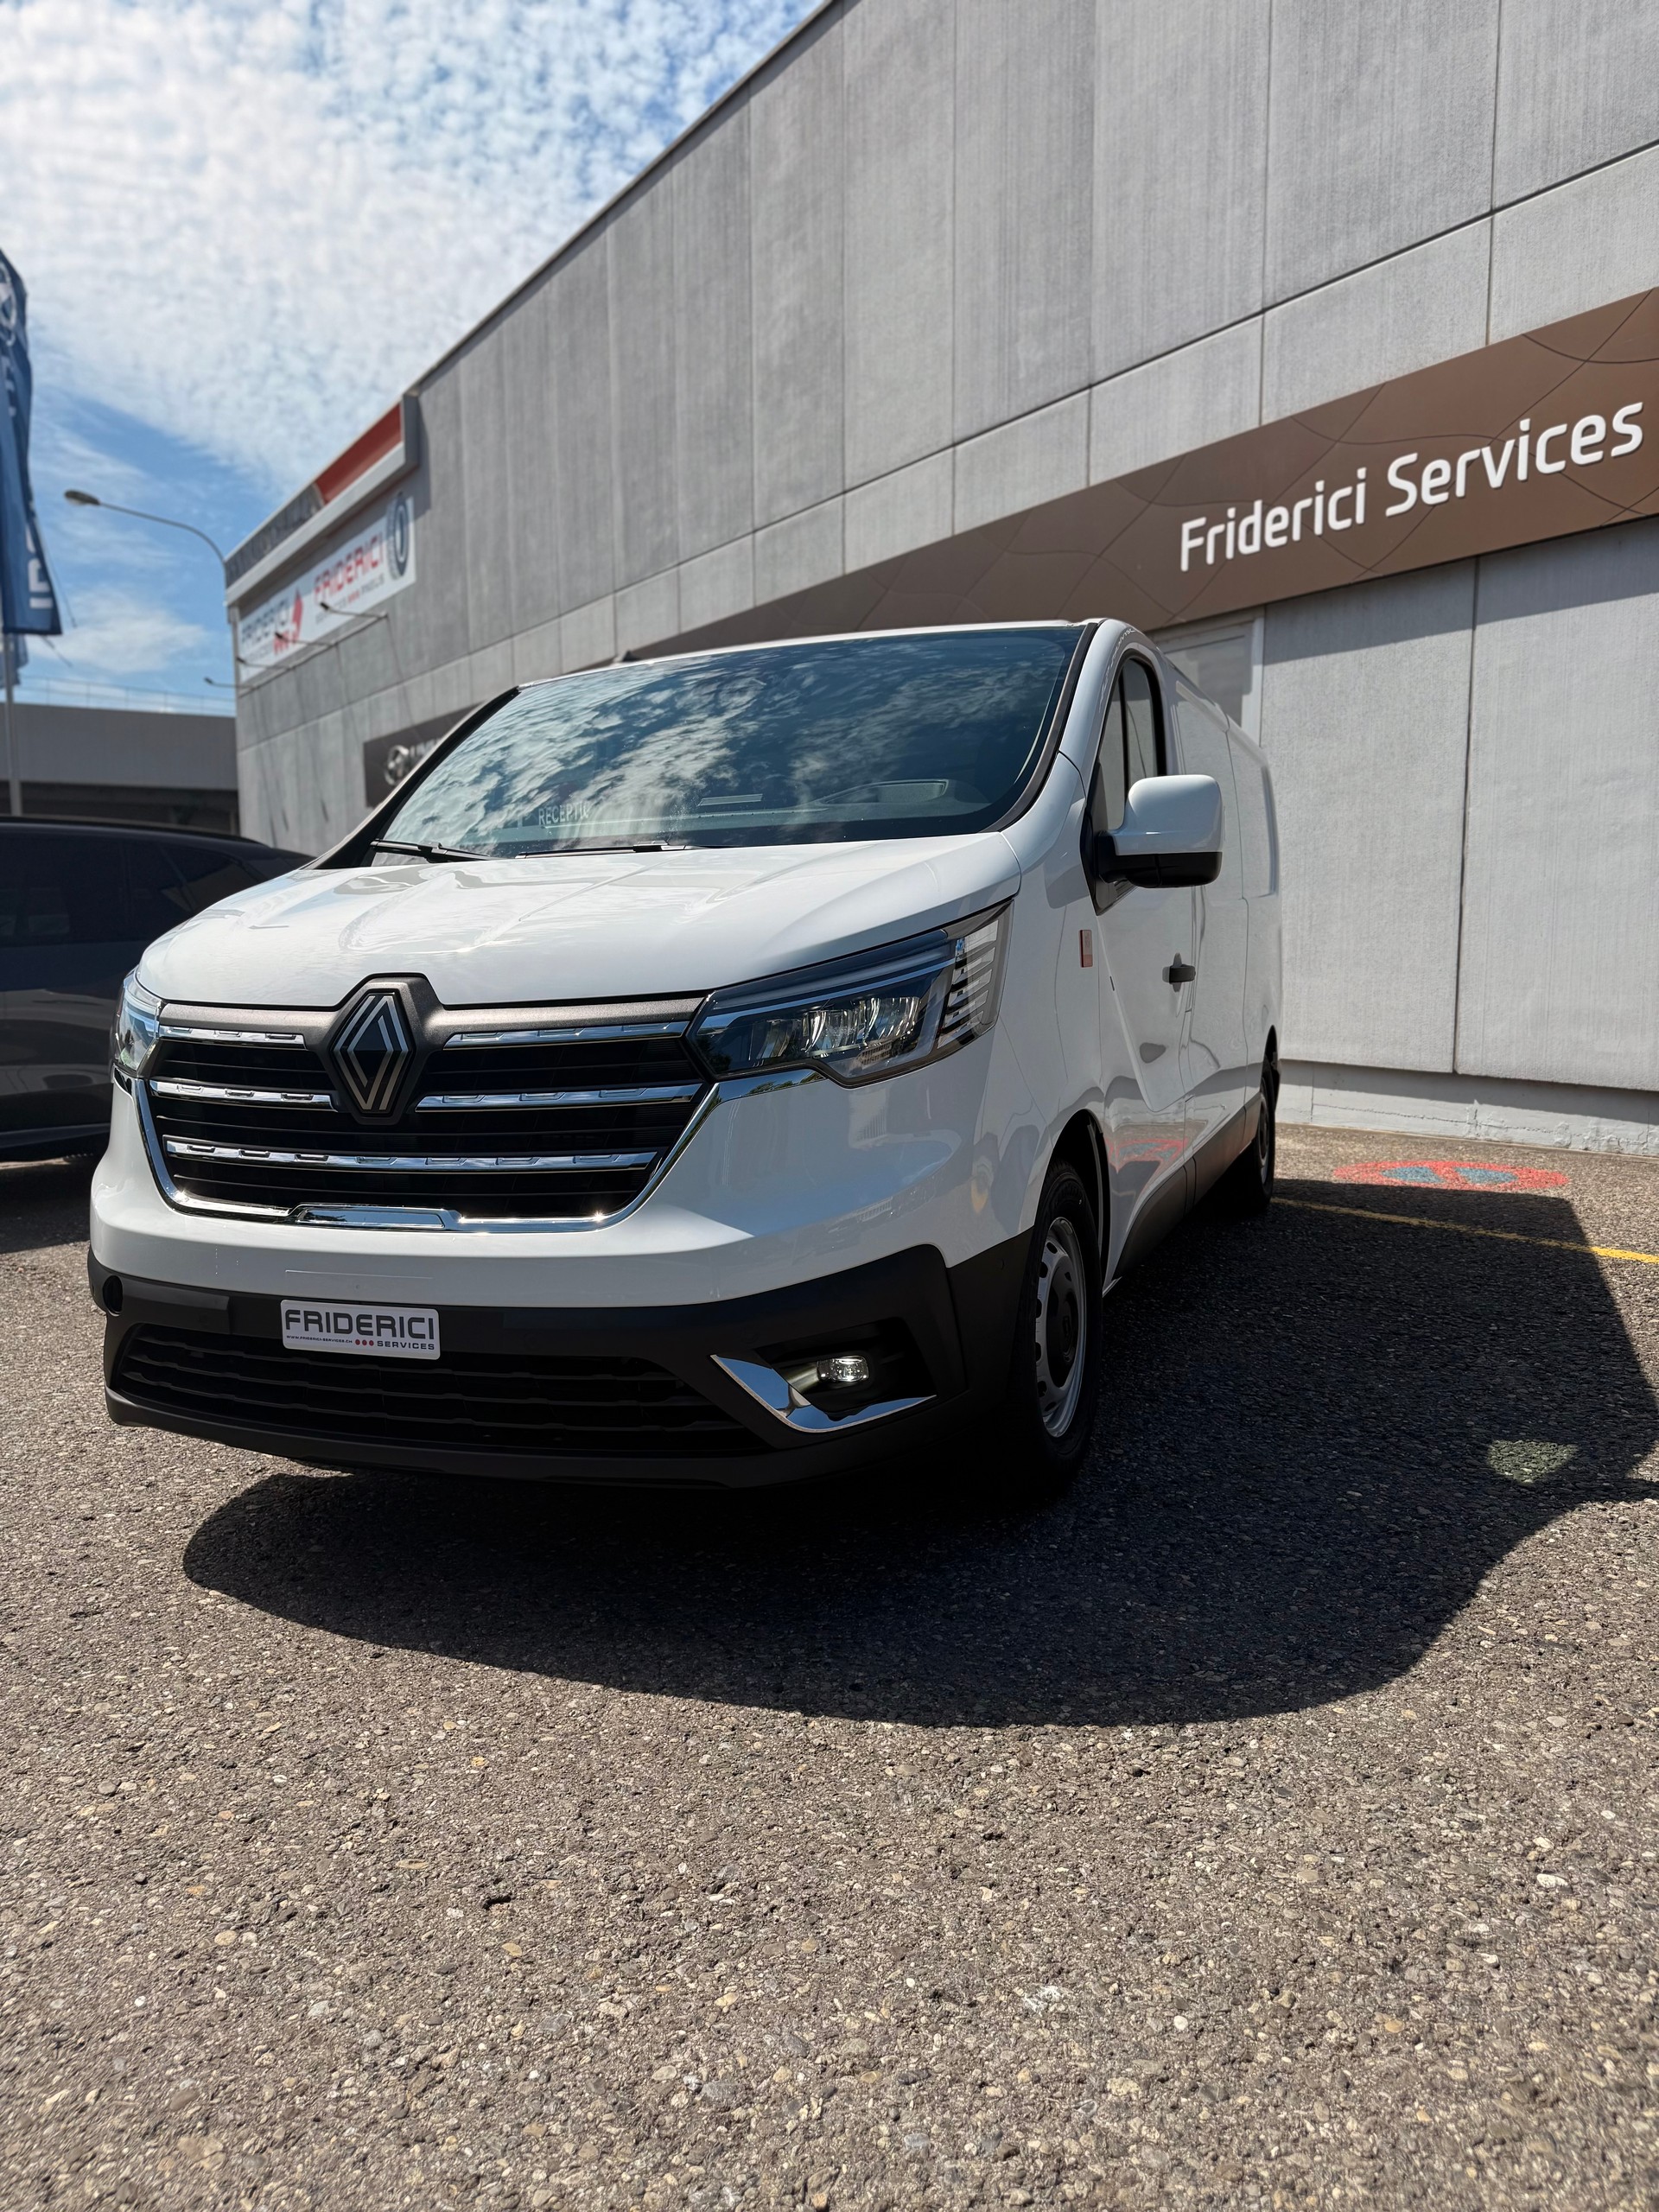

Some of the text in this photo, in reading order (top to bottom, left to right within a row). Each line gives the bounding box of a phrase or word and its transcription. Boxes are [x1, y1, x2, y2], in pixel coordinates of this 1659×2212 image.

[1180, 402, 1643, 572] Friderici Services
[285, 1309, 435, 1340] FRIDERICI
[377, 1340, 435, 1351] SERVICES
